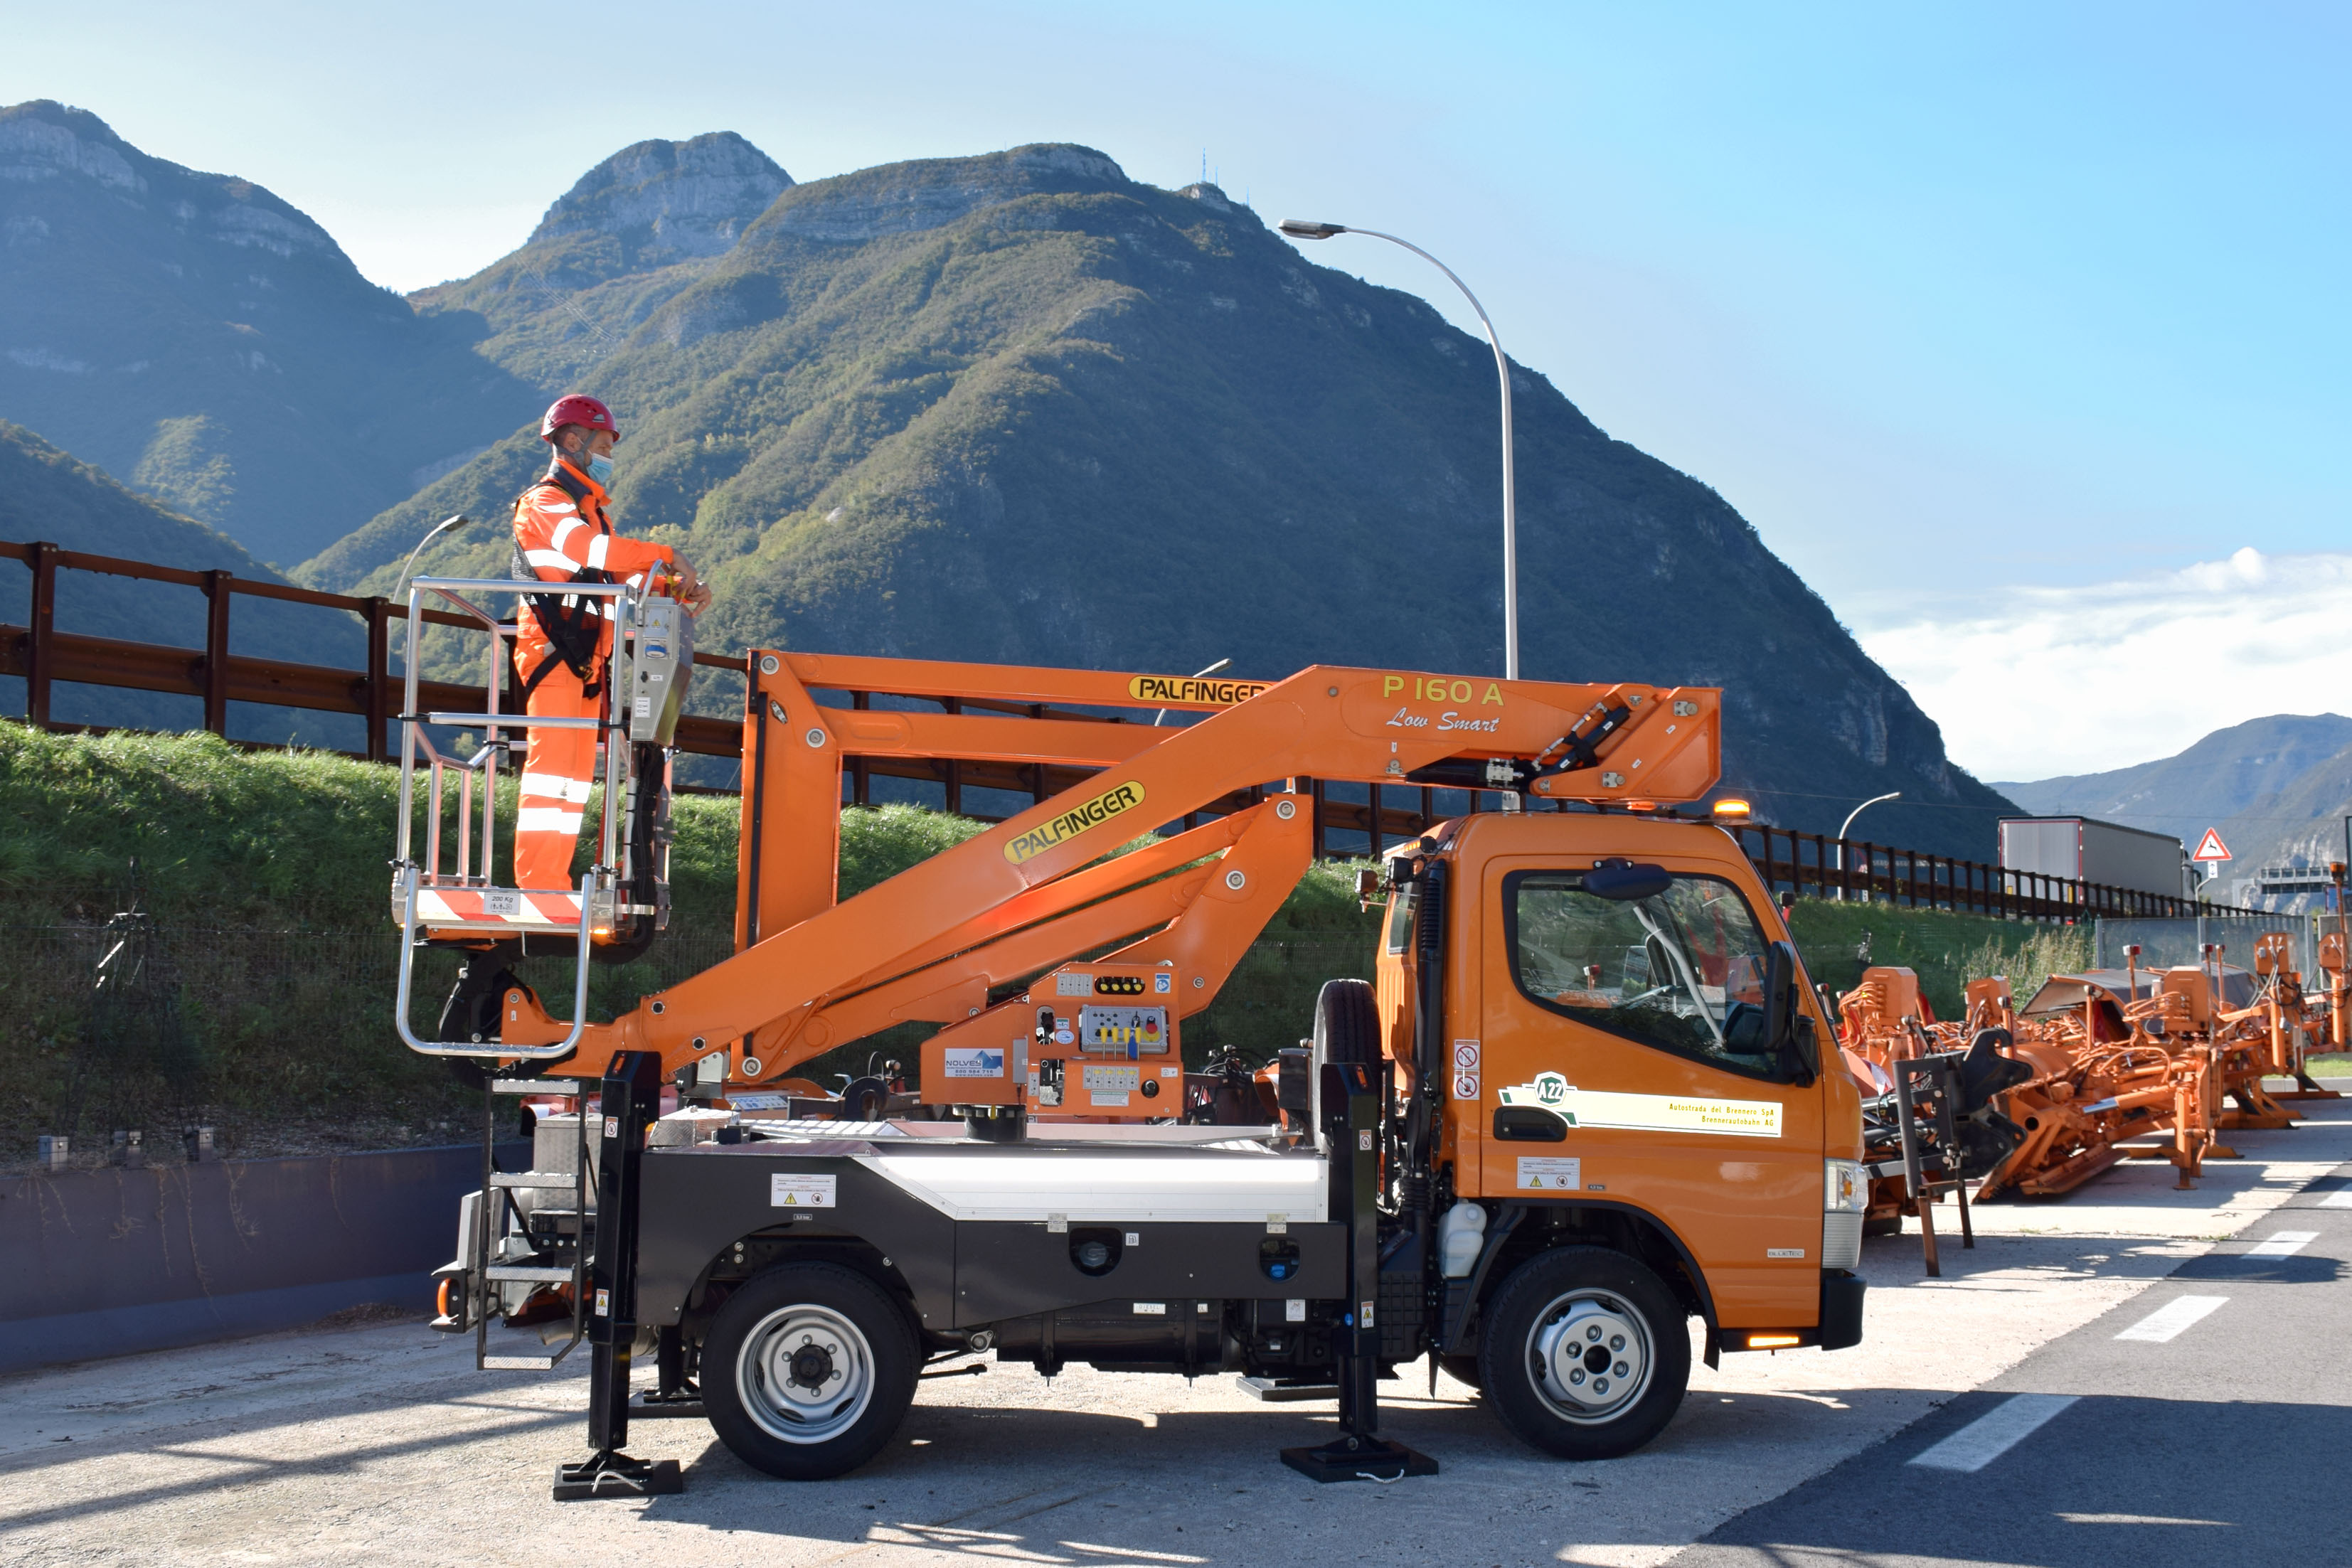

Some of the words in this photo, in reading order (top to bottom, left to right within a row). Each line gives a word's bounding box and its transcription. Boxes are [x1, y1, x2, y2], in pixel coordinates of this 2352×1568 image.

[1384, 676, 1405, 698] P
[1415, 677, 1473, 703] 160
[1481, 683, 1504, 706] A
[1386, 707, 1429, 727] Low
[1437, 711, 1500, 732] Smart
[1011, 786, 1137, 860] PALFINGER
[1669, 1103, 1707, 1113] Autostrada
[1726, 1106, 1757, 1115] Brennero
[1761, 1109, 1774, 1117] SpA
[1702, 1115, 1760, 1126] Brennerautobahn
